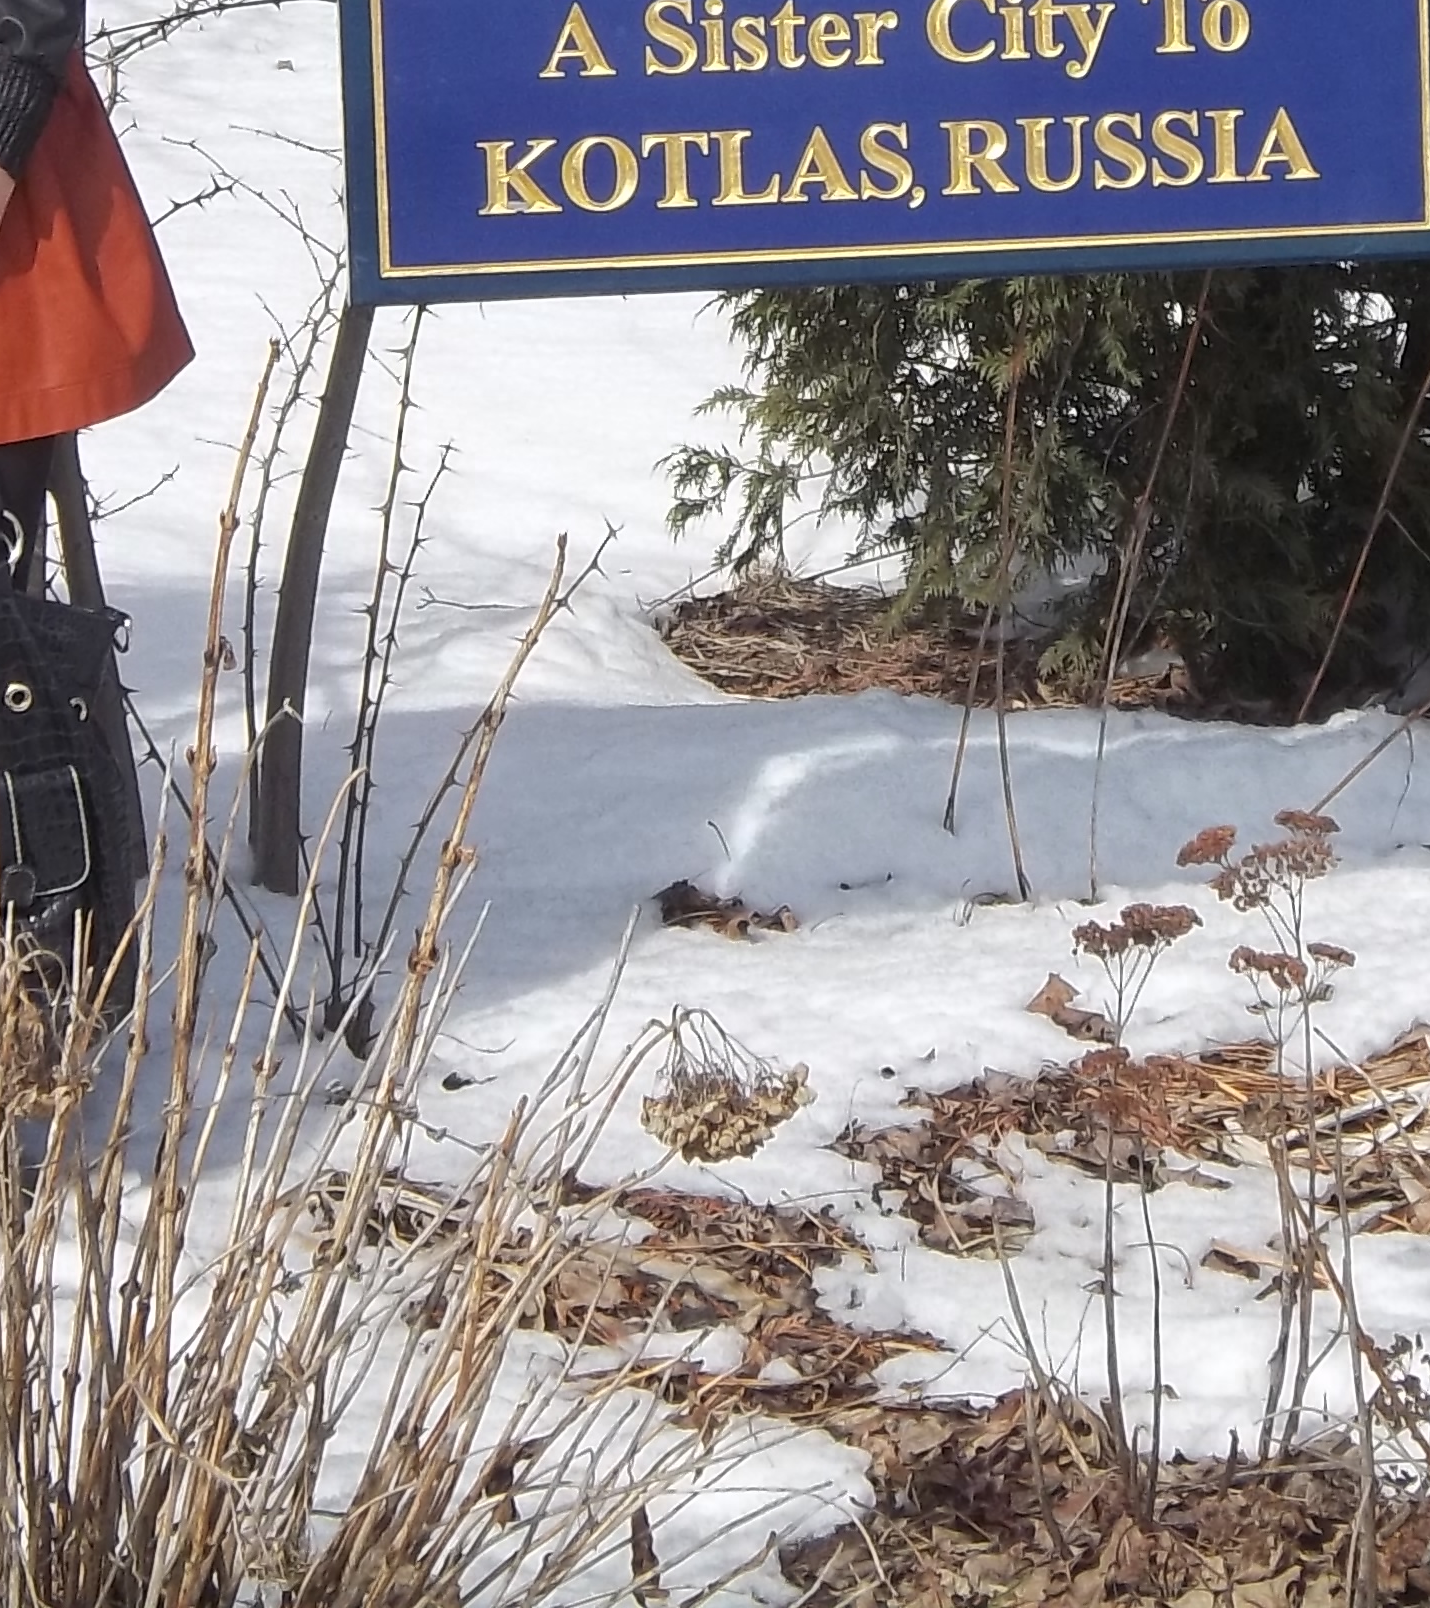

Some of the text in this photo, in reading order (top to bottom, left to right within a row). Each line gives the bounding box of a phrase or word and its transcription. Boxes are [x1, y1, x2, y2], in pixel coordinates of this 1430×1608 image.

[539, 1, 616, 78] A
[475, 106, 1321, 216] KOTLAS, RUSSIA
